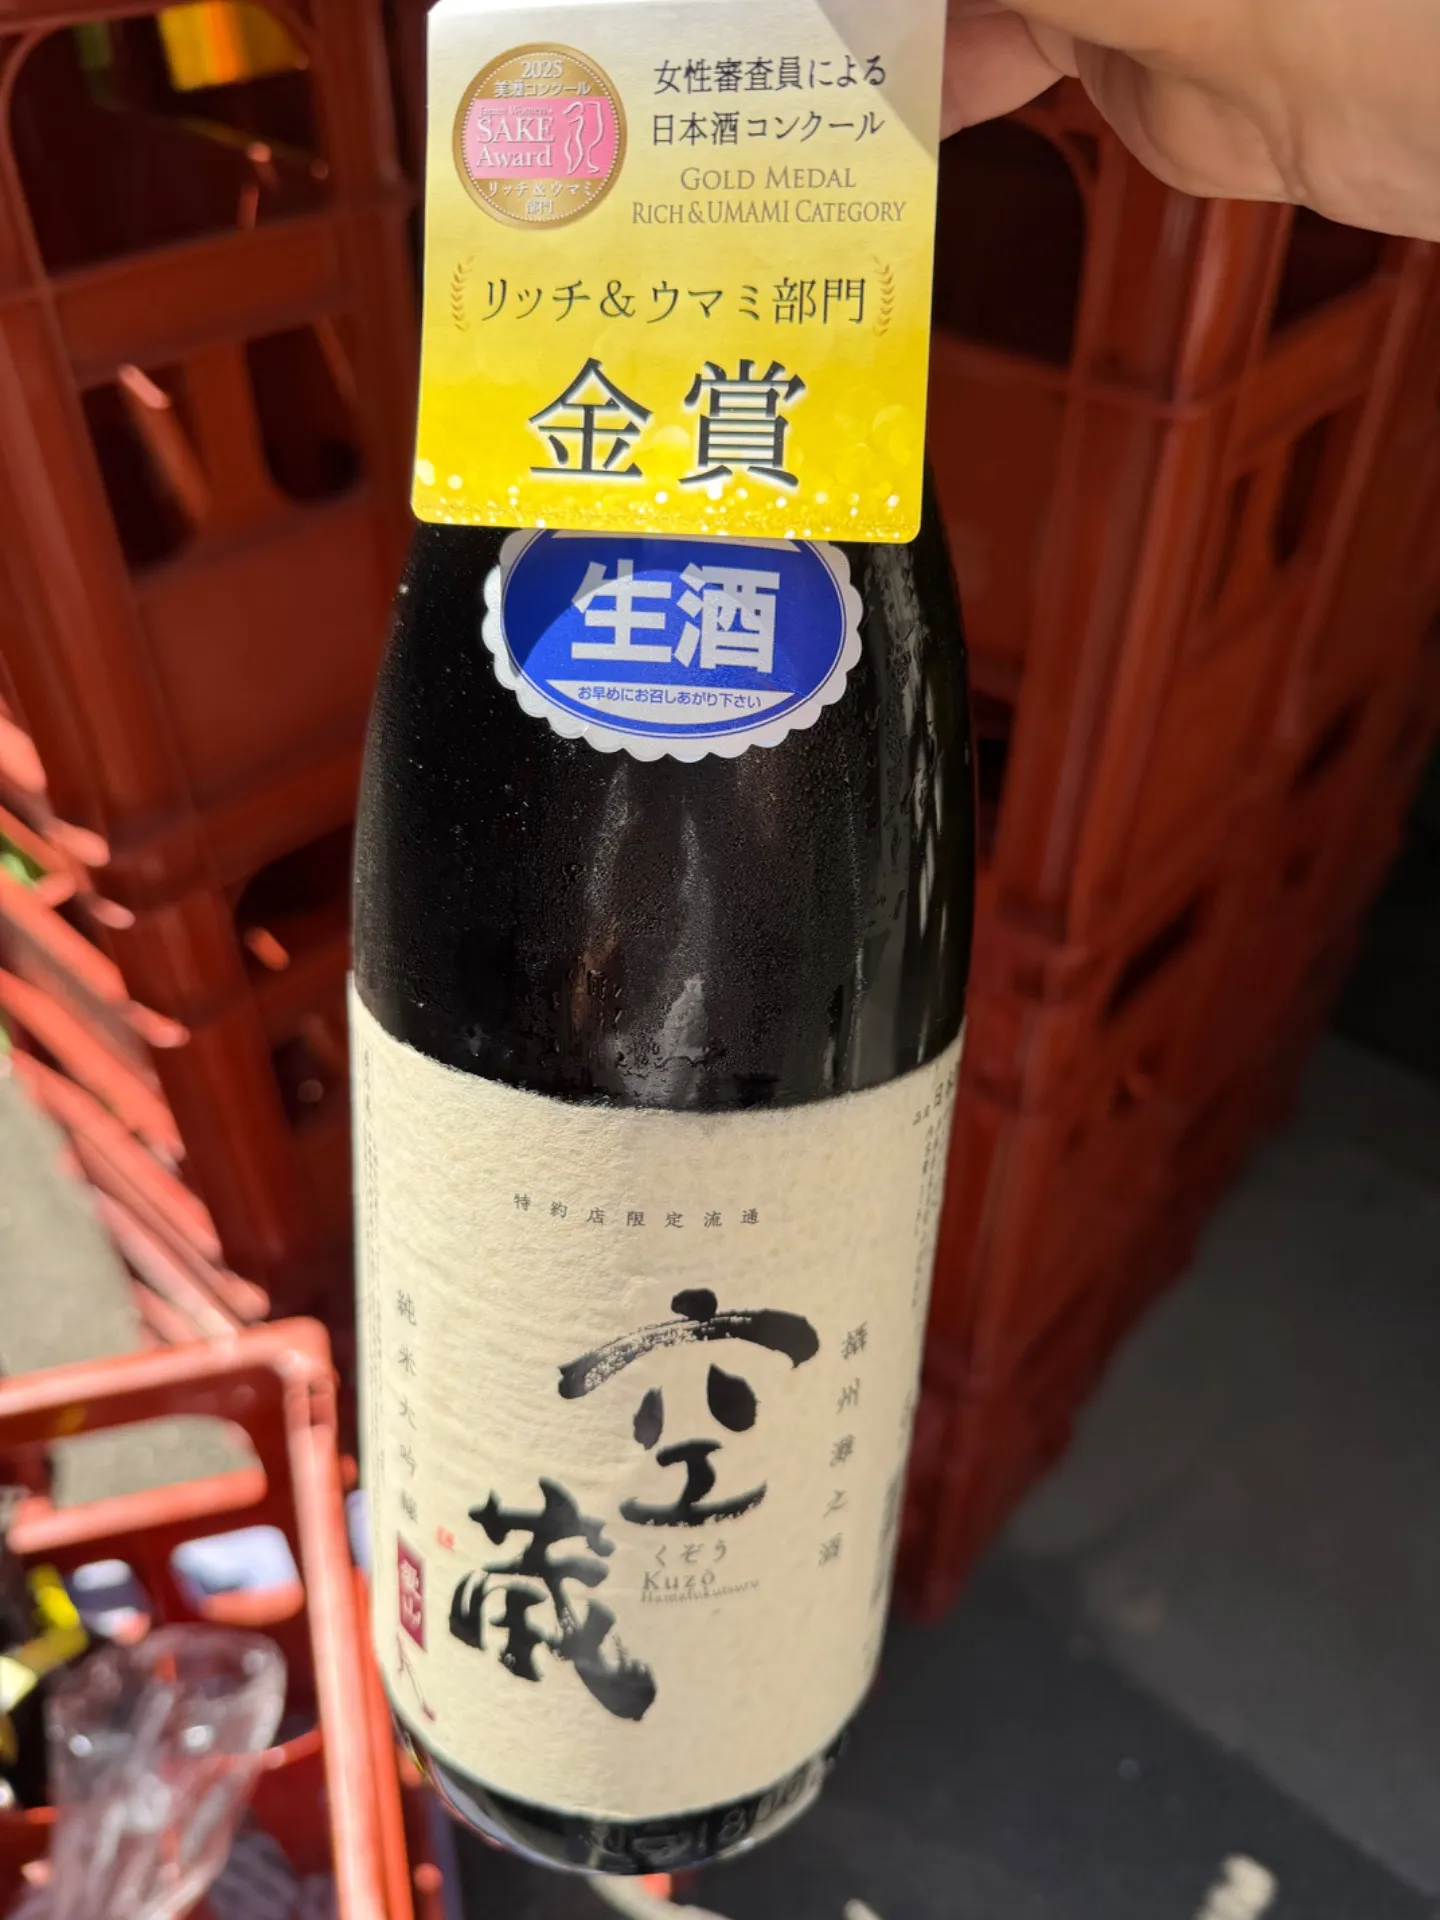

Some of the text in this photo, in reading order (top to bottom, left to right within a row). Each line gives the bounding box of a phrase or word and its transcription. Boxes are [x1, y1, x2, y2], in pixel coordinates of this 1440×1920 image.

[521, 60, 565, 79] 2025
[653, 54, 887, 95] 女性審査員による
[476, 116, 555, 143] SAKE
[653, 110, 887, 146] 日本酒コンクール
[475, 145, 554, 168] Award
[680, 165, 857, 190] GOLD MEDAL
[525, 200, 555, 215] 部門
[795, 199, 907, 223] CATEGORY
[528, 356, 808, 489] 金賞
[570, 558, 781, 674] 生酒
[577, 686, 763, 709] お早めにお召しあがり下さい
[513, 1193, 761, 1229] 特約店限定流通
[654, 1538, 728, 1568] くぞう
